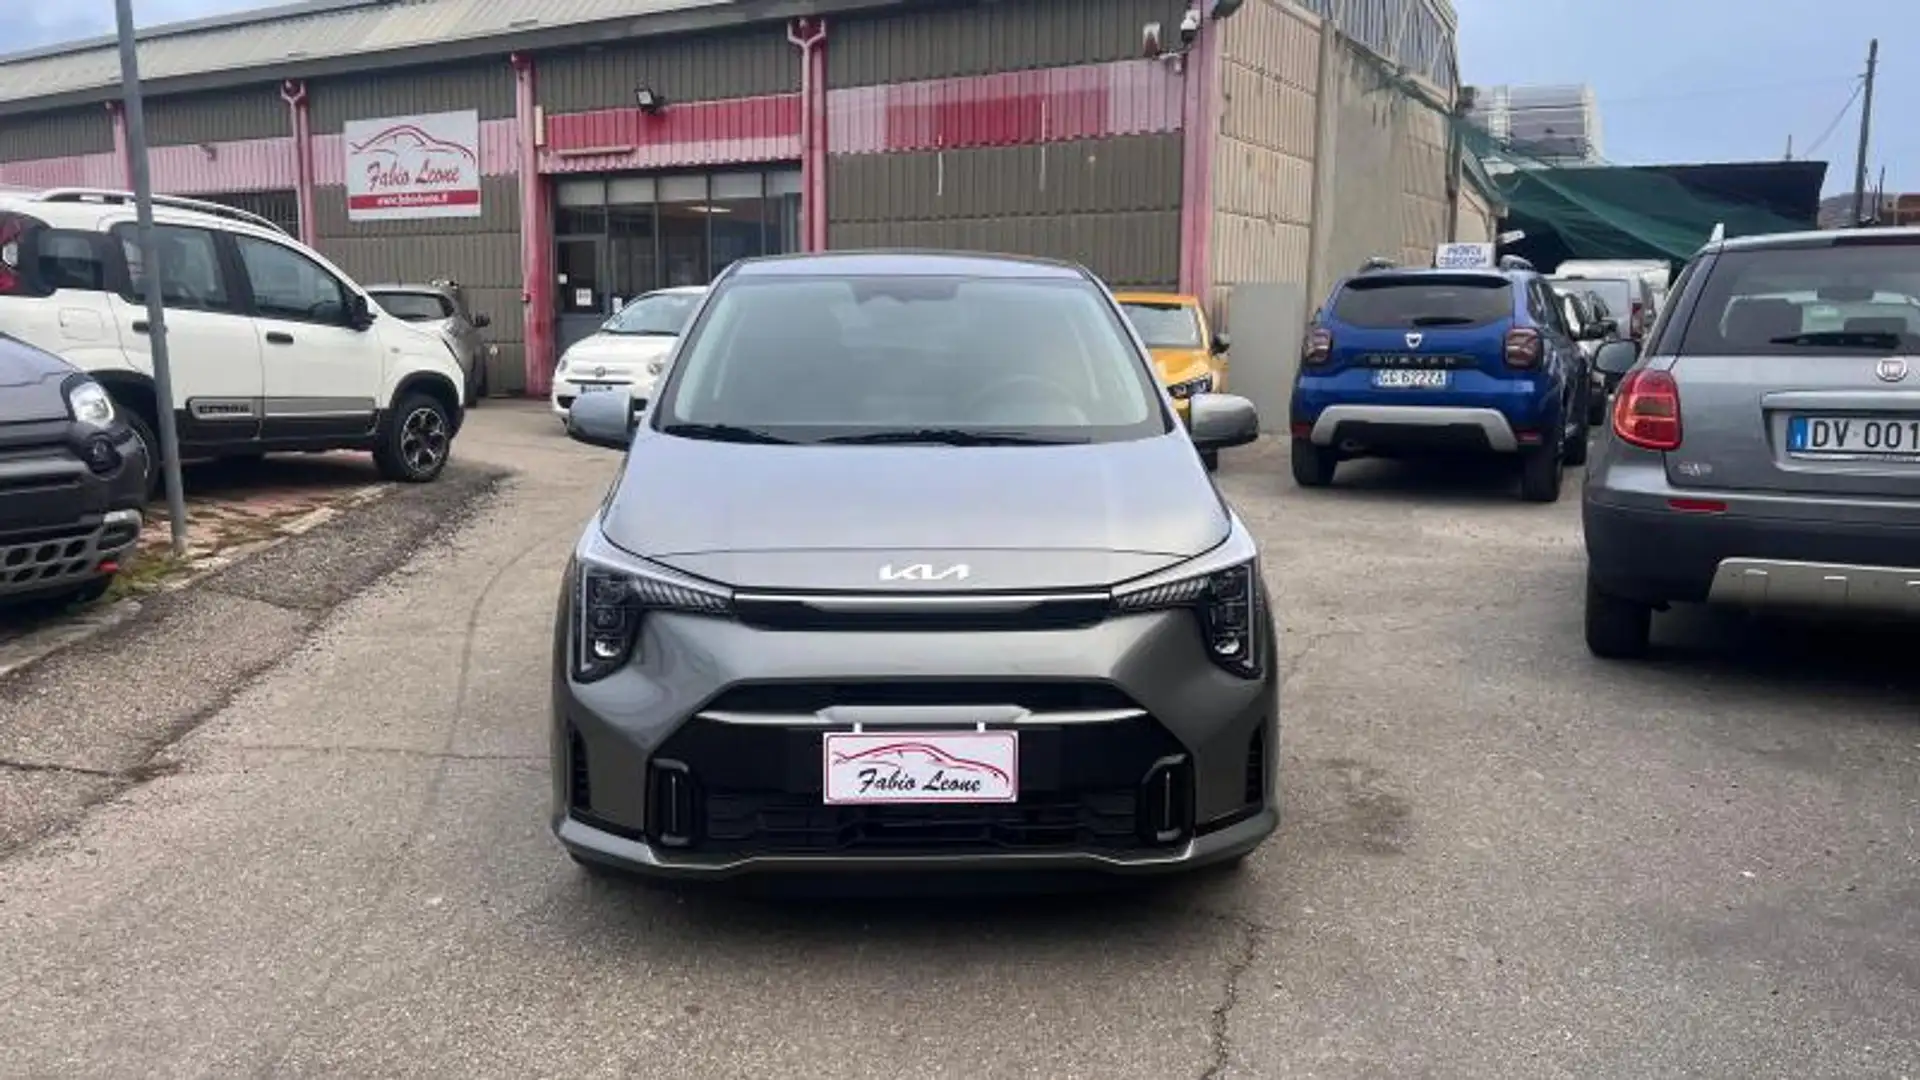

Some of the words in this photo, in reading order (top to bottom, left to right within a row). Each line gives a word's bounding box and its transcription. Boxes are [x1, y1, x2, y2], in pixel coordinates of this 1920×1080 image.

[1812, 420, 1850, 448] DV
[858, 768, 916, 793] Fabio
[922, 770, 981, 792] Leone
